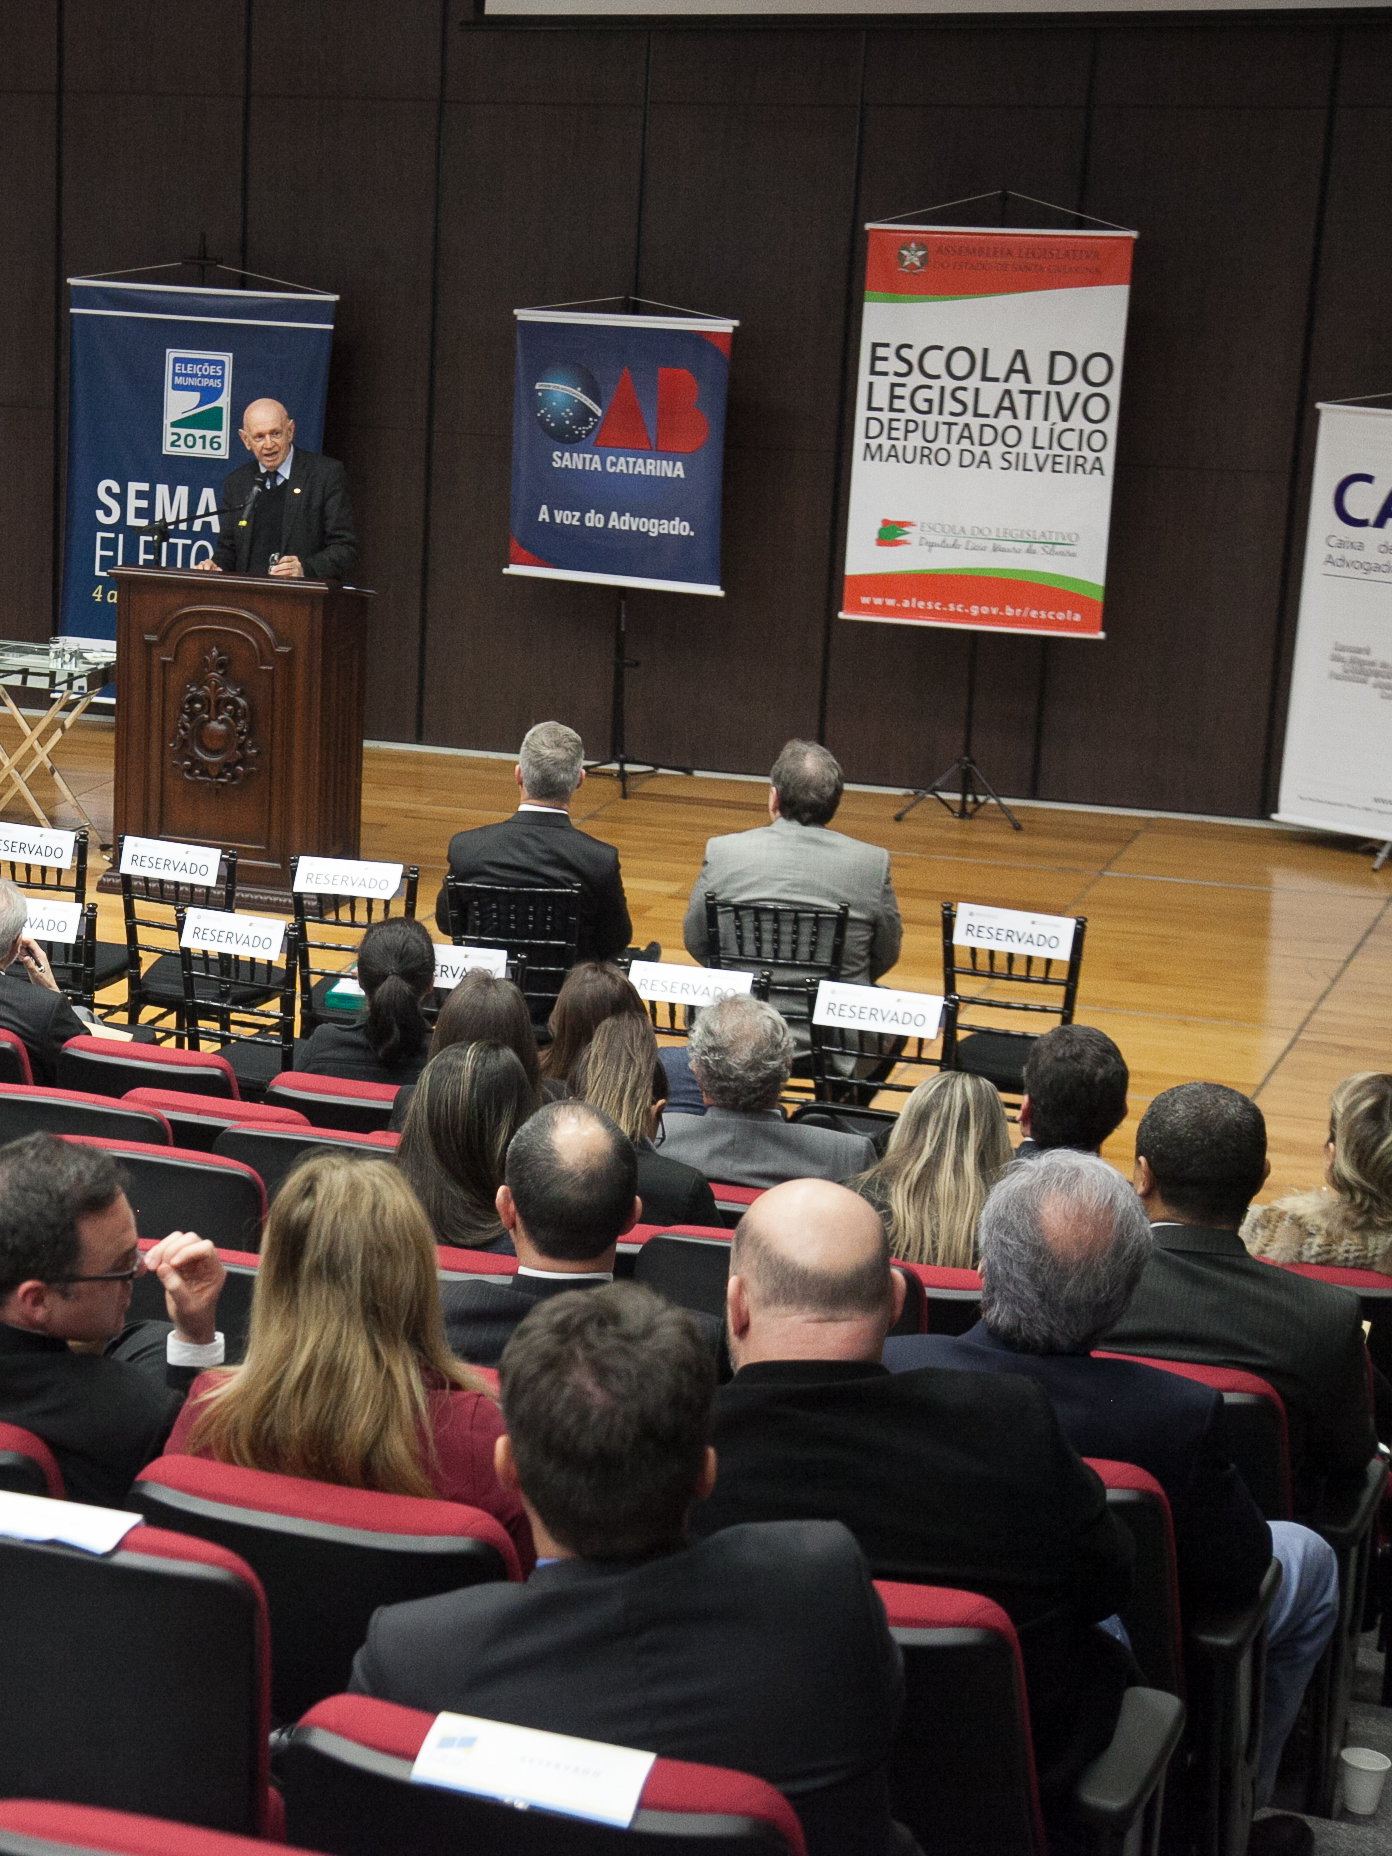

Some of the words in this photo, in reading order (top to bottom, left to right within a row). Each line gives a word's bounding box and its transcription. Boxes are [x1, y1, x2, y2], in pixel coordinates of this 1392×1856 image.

[175, 362, 223, 377] ELEIÇÕES
[869, 342, 1032, 385] ESCOLA
[1047, 350, 1114, 388] DO
[174, 376, 222, 388] MUNICIPAIS
[866, 381, 1110, 424] LEGISLATIVO
[170, 432, 222, 451] 2016
[864, 416, 1022, 448] DEPUTADO
[1032, 421, 1108, 453] LÍCIO
[551, 451, 602, 472] SANTA
[606, 455, 685, 478] CATARINA
[862, 443, 951, 467] MAURO
[959, 448, 993, 470] DA
[1000, 451, 1106, 477] SILVEIRA
[537, 504, 550, 523] A
[554, 509, 581, 526] voz
[584, 509, 605, 528] do
[608, 511, 695, 537] Advogado.
[919, 522, 966, 537] ESCOLA
[970, 526, 992, 538] DO
[995, 527, 1080, 543] LEGISLATIVO
[1325, 534, 1365, 551] Caixa
[92, 585, 103, 602] 4
[859, 595, 1082, 623] www.alesc.sc.gov.br/escola
[130, 854, 209, 877] RESERVADO
[305, 872, 390, 891] RESERVADO
[192, 926, 272, 950] RESERVADO
[965, 923, 1060, 949] RESERVADO
[826, 1002, 926, 1027] RESERVADO
